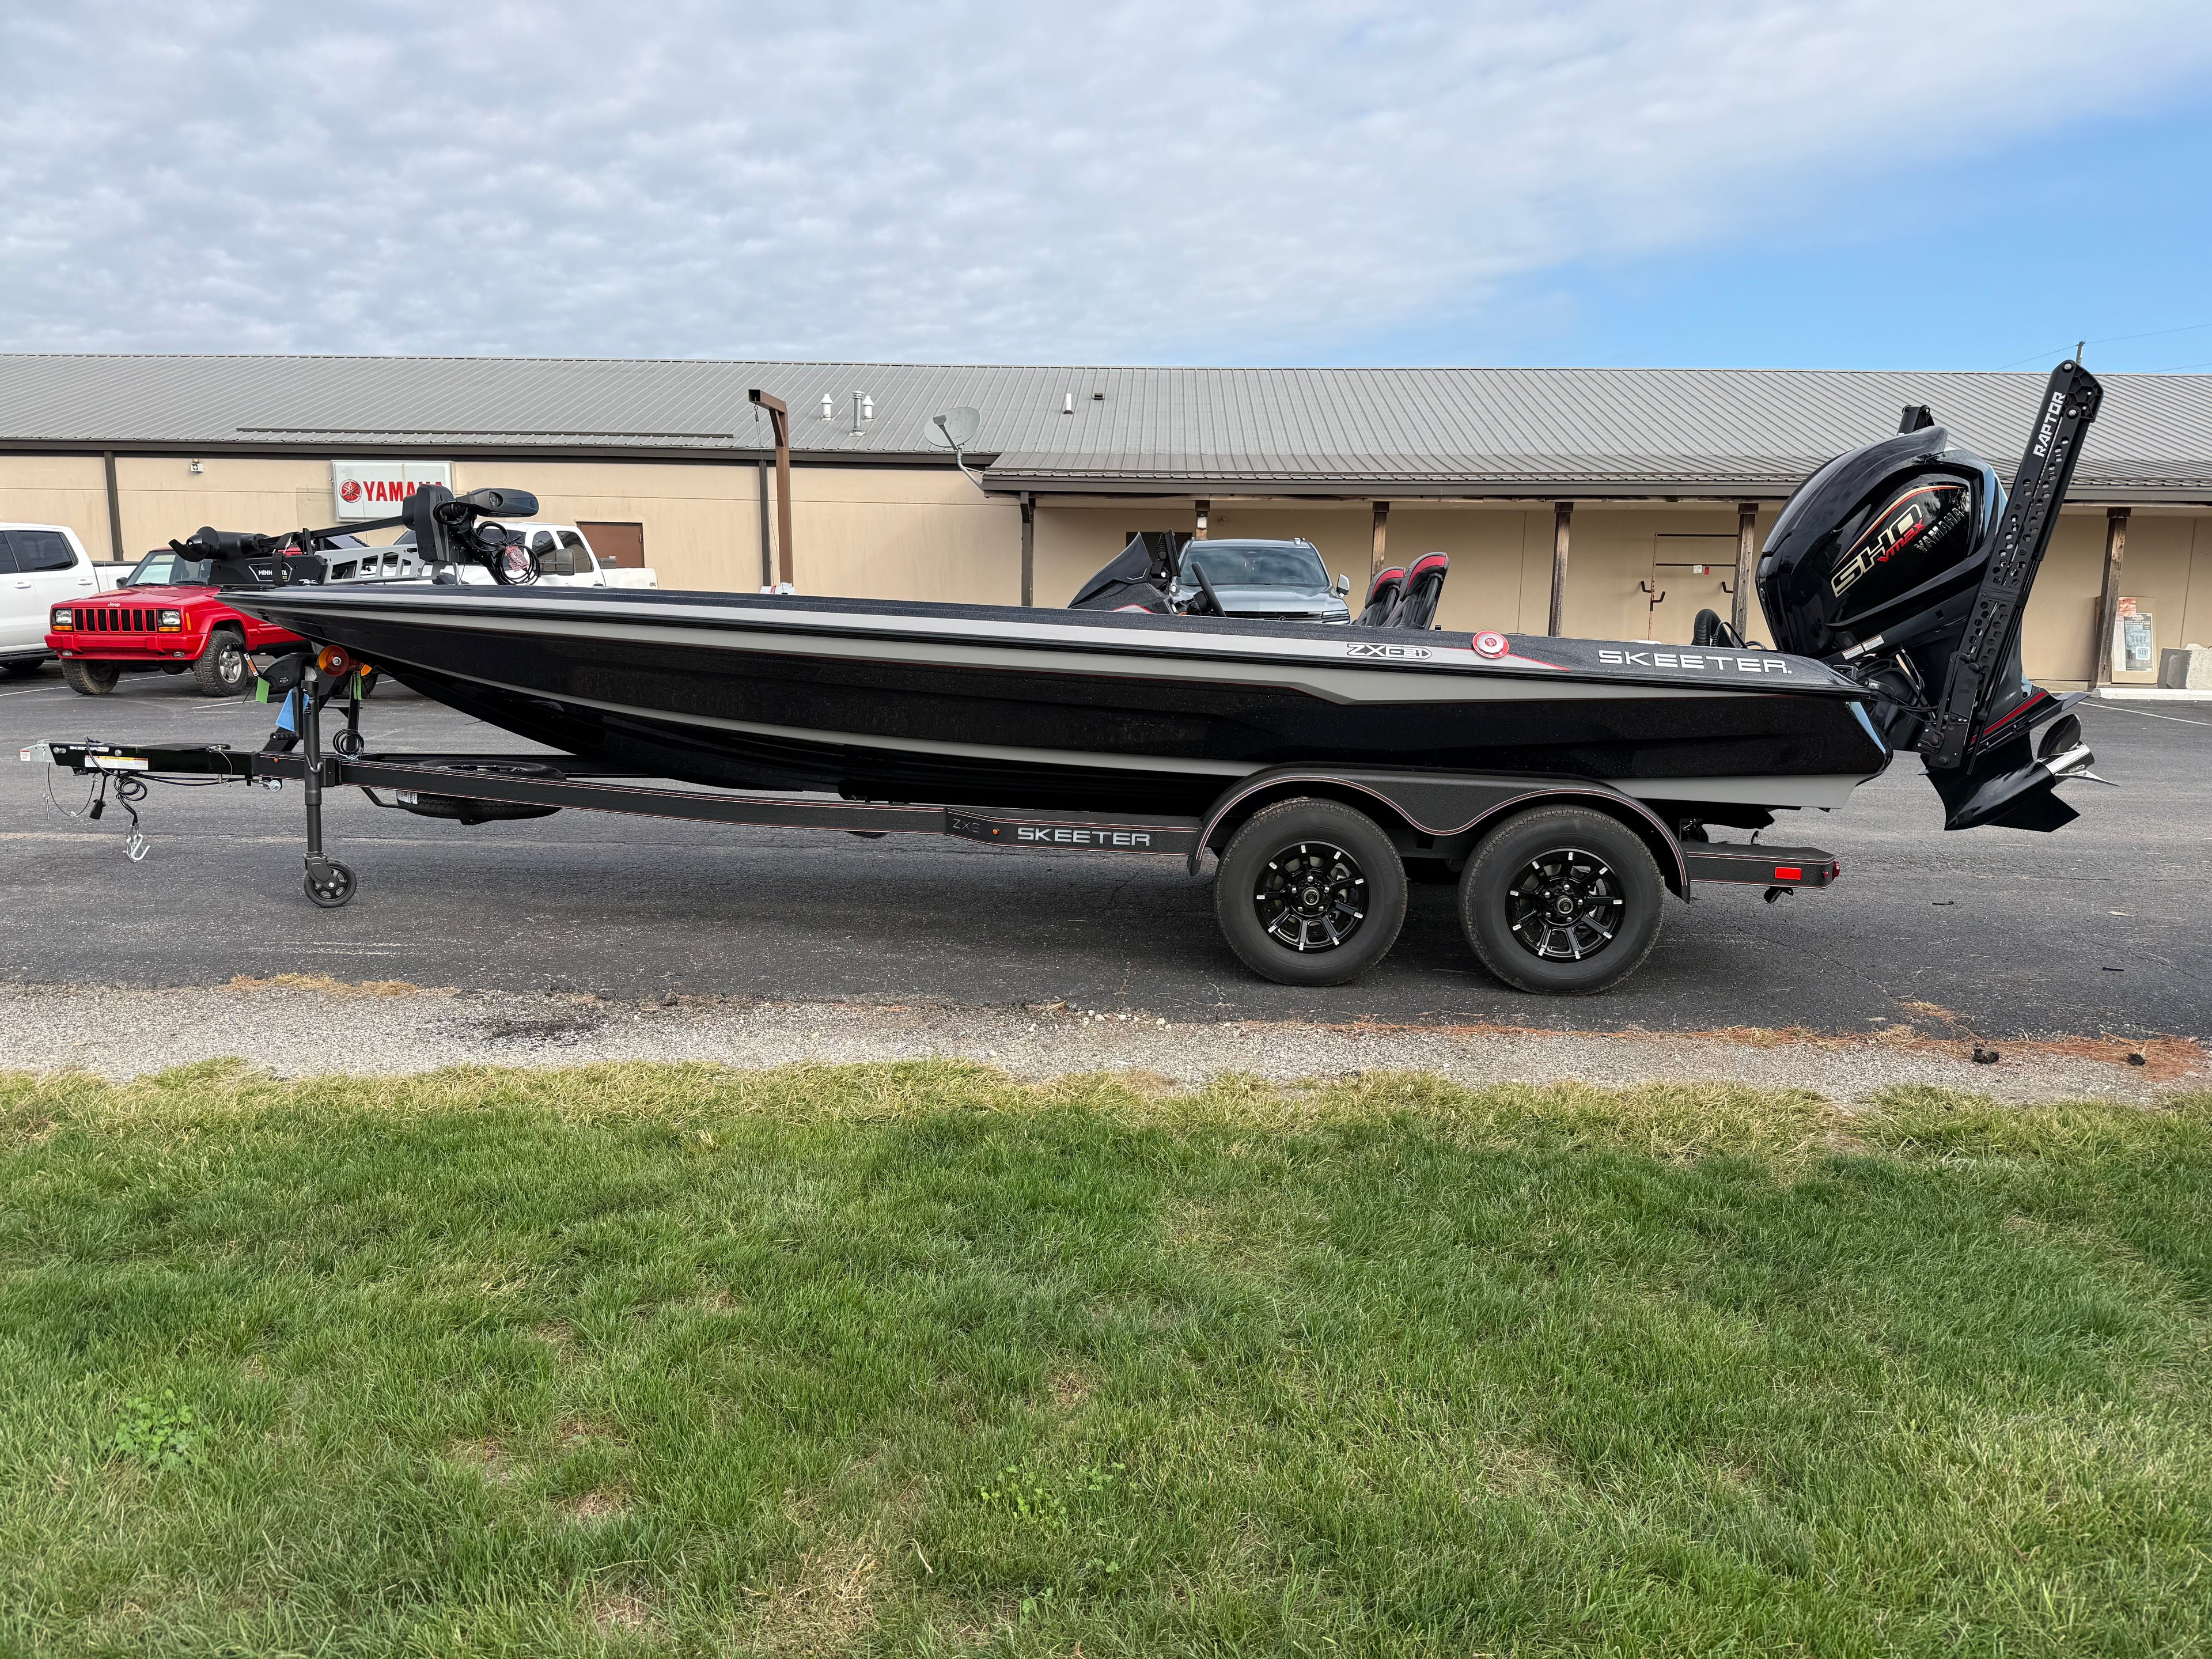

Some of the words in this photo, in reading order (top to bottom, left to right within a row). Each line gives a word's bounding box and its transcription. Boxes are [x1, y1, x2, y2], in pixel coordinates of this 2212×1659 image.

[2033, 391, 2066, 457] RAPTOR
[363, 481, 442, 502] YAMA
[1914, 507, 1965, 553] YAMAHA
[1831, 503, 1922, 598] SHO
[953, 818, 980, 833] ZXE
[1017, 827, 1150, 847] SKEETER
